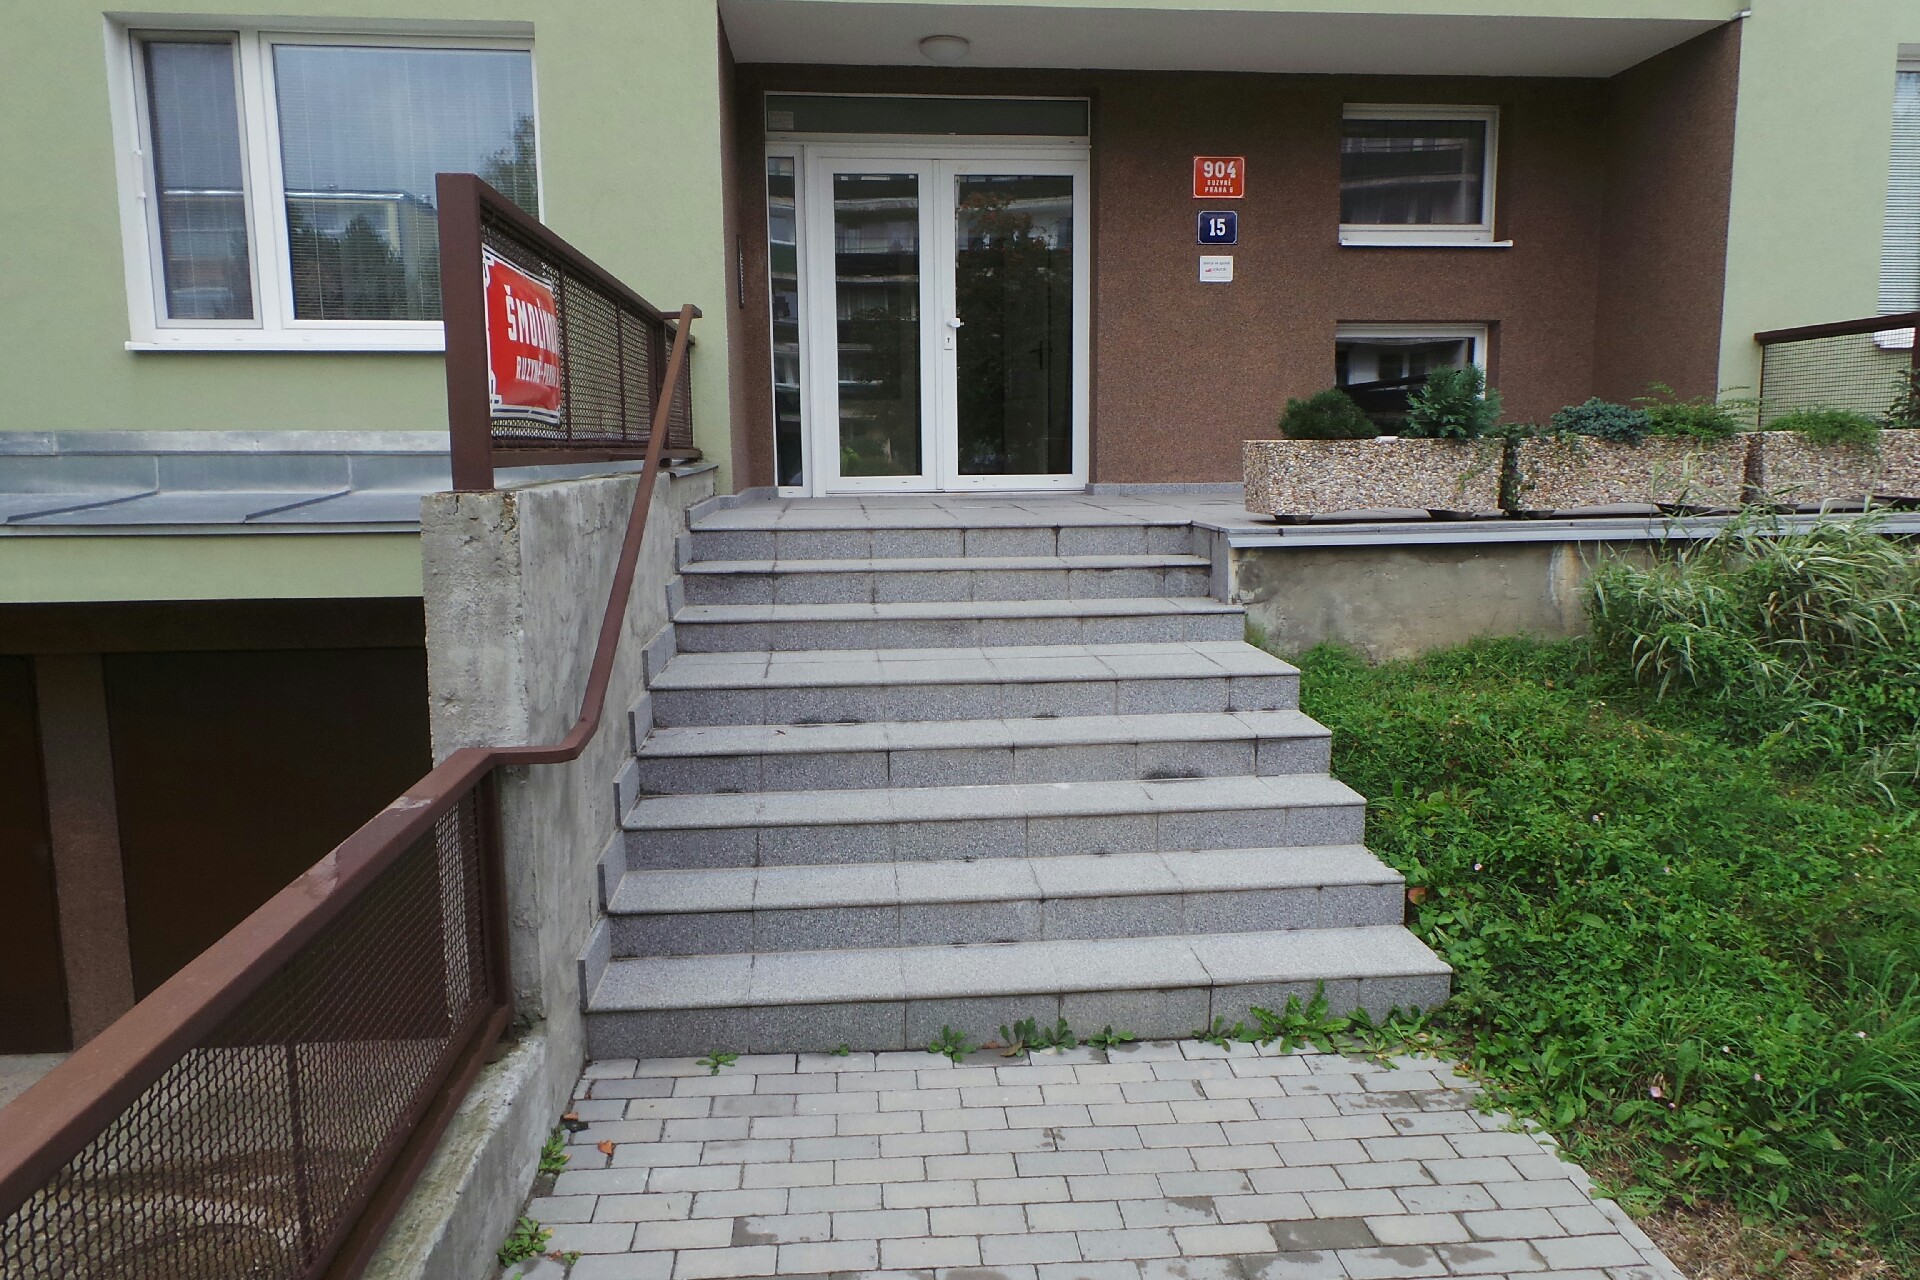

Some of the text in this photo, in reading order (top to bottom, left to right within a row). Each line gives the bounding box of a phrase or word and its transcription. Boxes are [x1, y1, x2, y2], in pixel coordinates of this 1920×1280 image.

[1203, 161, 1236, 178] 904
[1209, 218, 1226, 236] 15
[503, 284, 559, 354] ŠMOLÍ
